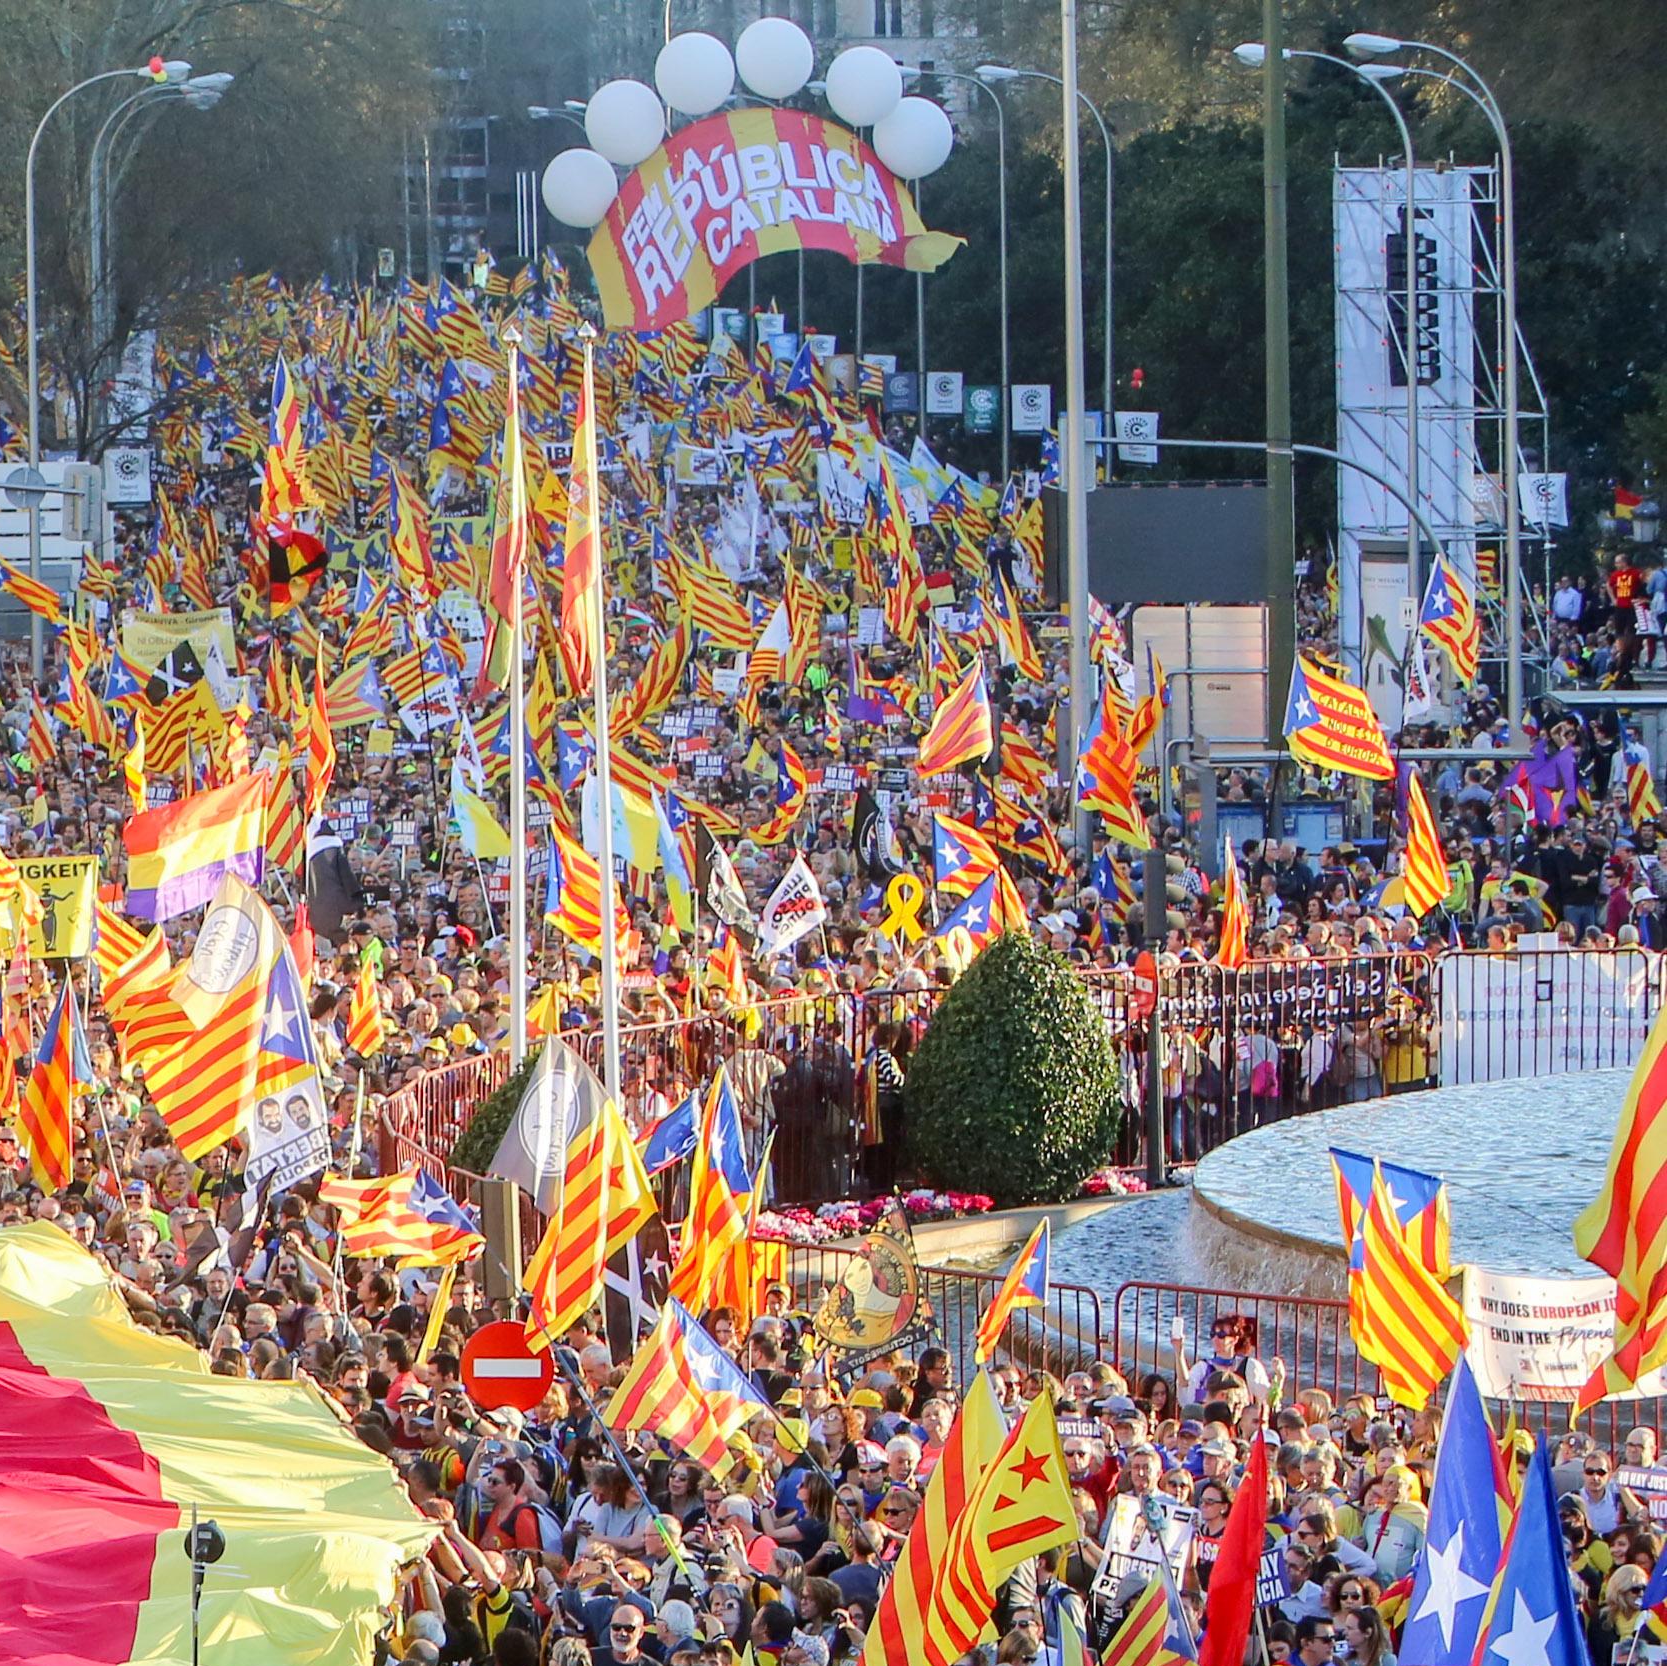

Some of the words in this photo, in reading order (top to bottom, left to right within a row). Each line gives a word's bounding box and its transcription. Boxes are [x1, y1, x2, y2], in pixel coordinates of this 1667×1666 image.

[623, 178, 668, 256] FEM
[661, 147, 702, 190] LA
[636, 142, 892, 314] REPÚBLICA
[705, 184, 896, 265] CATALANA
[1501, 1300, 1530, 1318] DOES
[1533, 1299, 1599, 1319] EUROPEAN
[1491, 1327, 1515, 1345] END
[1516, 1328, 1526, 1345] IN
[1529, 1328, 1551, 1346] THE
[1057, 1417, 1100, 1436] USTÍCIA
[1630, 1472, 1646, 1486] HAY
